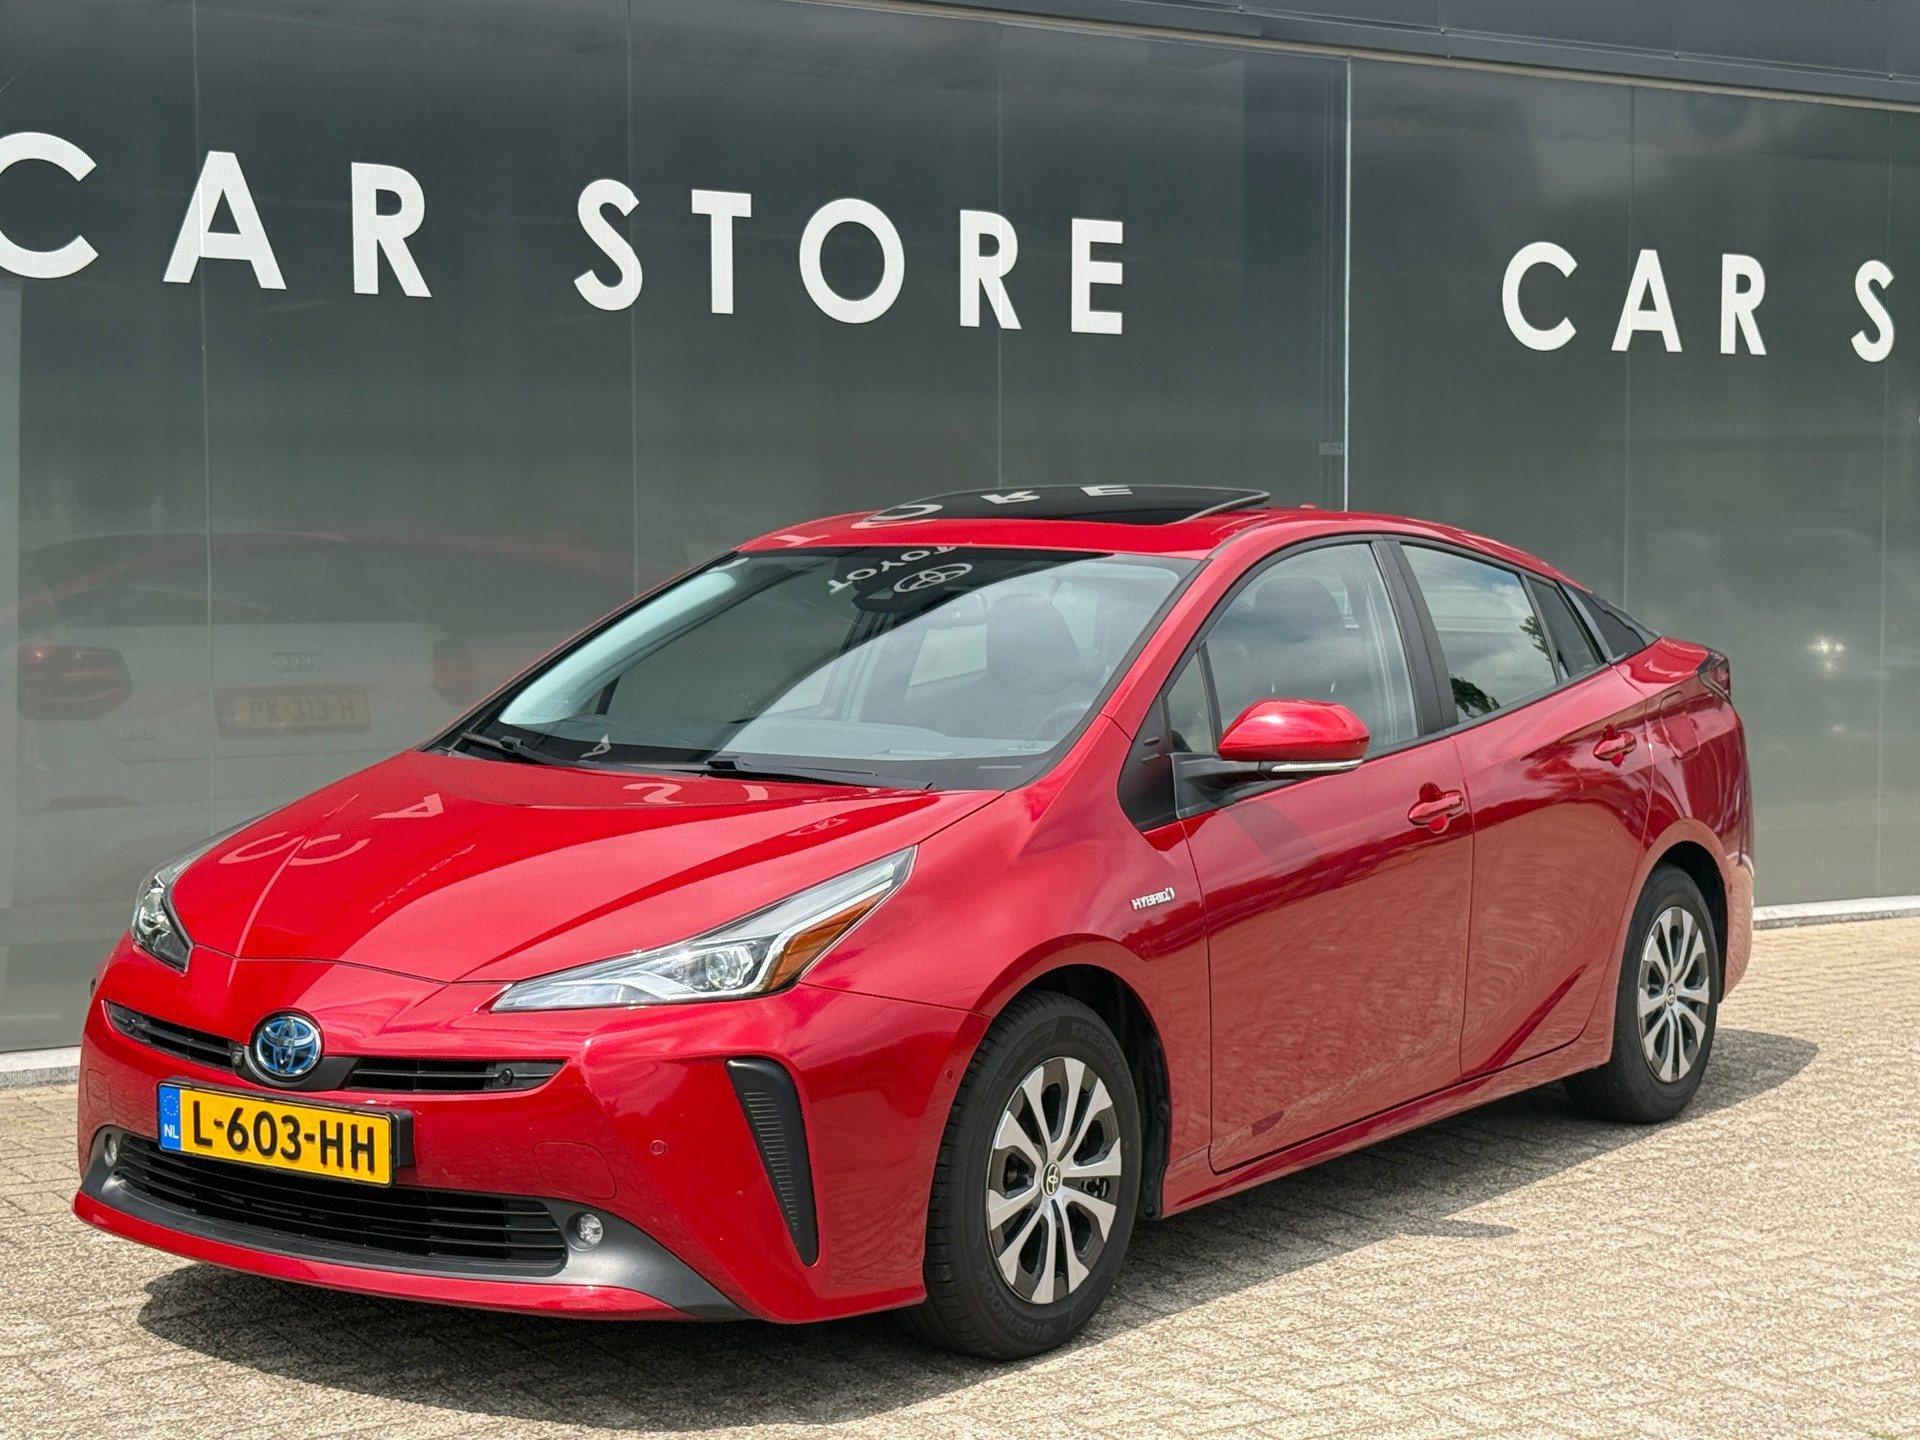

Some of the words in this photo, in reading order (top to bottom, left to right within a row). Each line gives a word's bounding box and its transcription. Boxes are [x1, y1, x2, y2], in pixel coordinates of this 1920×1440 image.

[0, 131, 433, 298] CAR
[573, 178, 1124, 335] STORE
[1501, 241, 1768, 356] CAR
[1850, 259, 1896, 363] S
[1130, 890, 1170, 911] HYBRID
[164, 1123, 179, 1139] NL
[192, 1100, 375, 1173] L-603-HH
